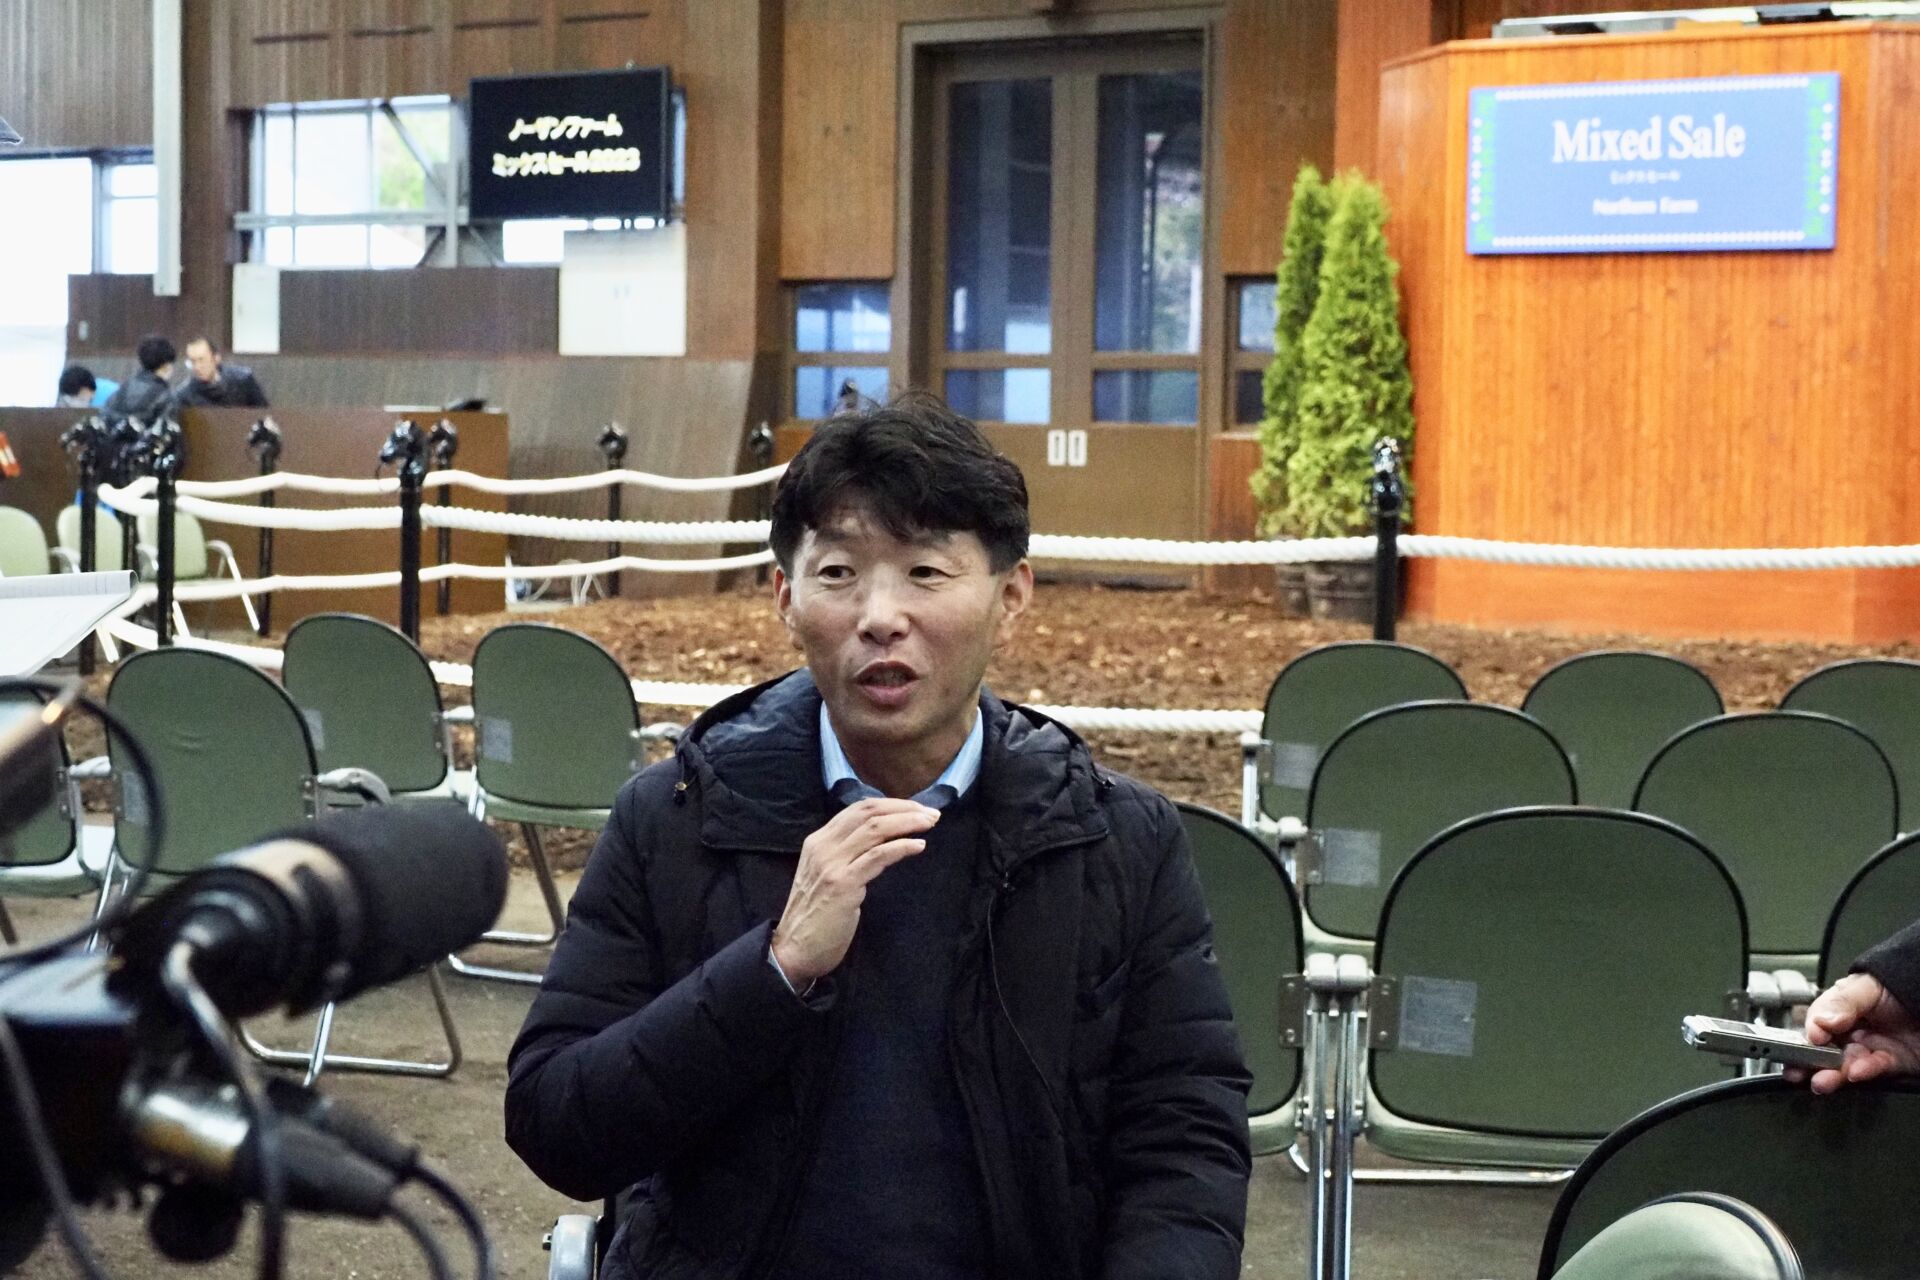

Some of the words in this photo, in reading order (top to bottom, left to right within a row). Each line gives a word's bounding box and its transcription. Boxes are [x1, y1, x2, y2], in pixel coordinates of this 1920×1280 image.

[508, 113, 623, 141] ノーザンファーム
[1552, 114, 1662, 163] Mixed
[1668, 112, 1746, 160] Sale
